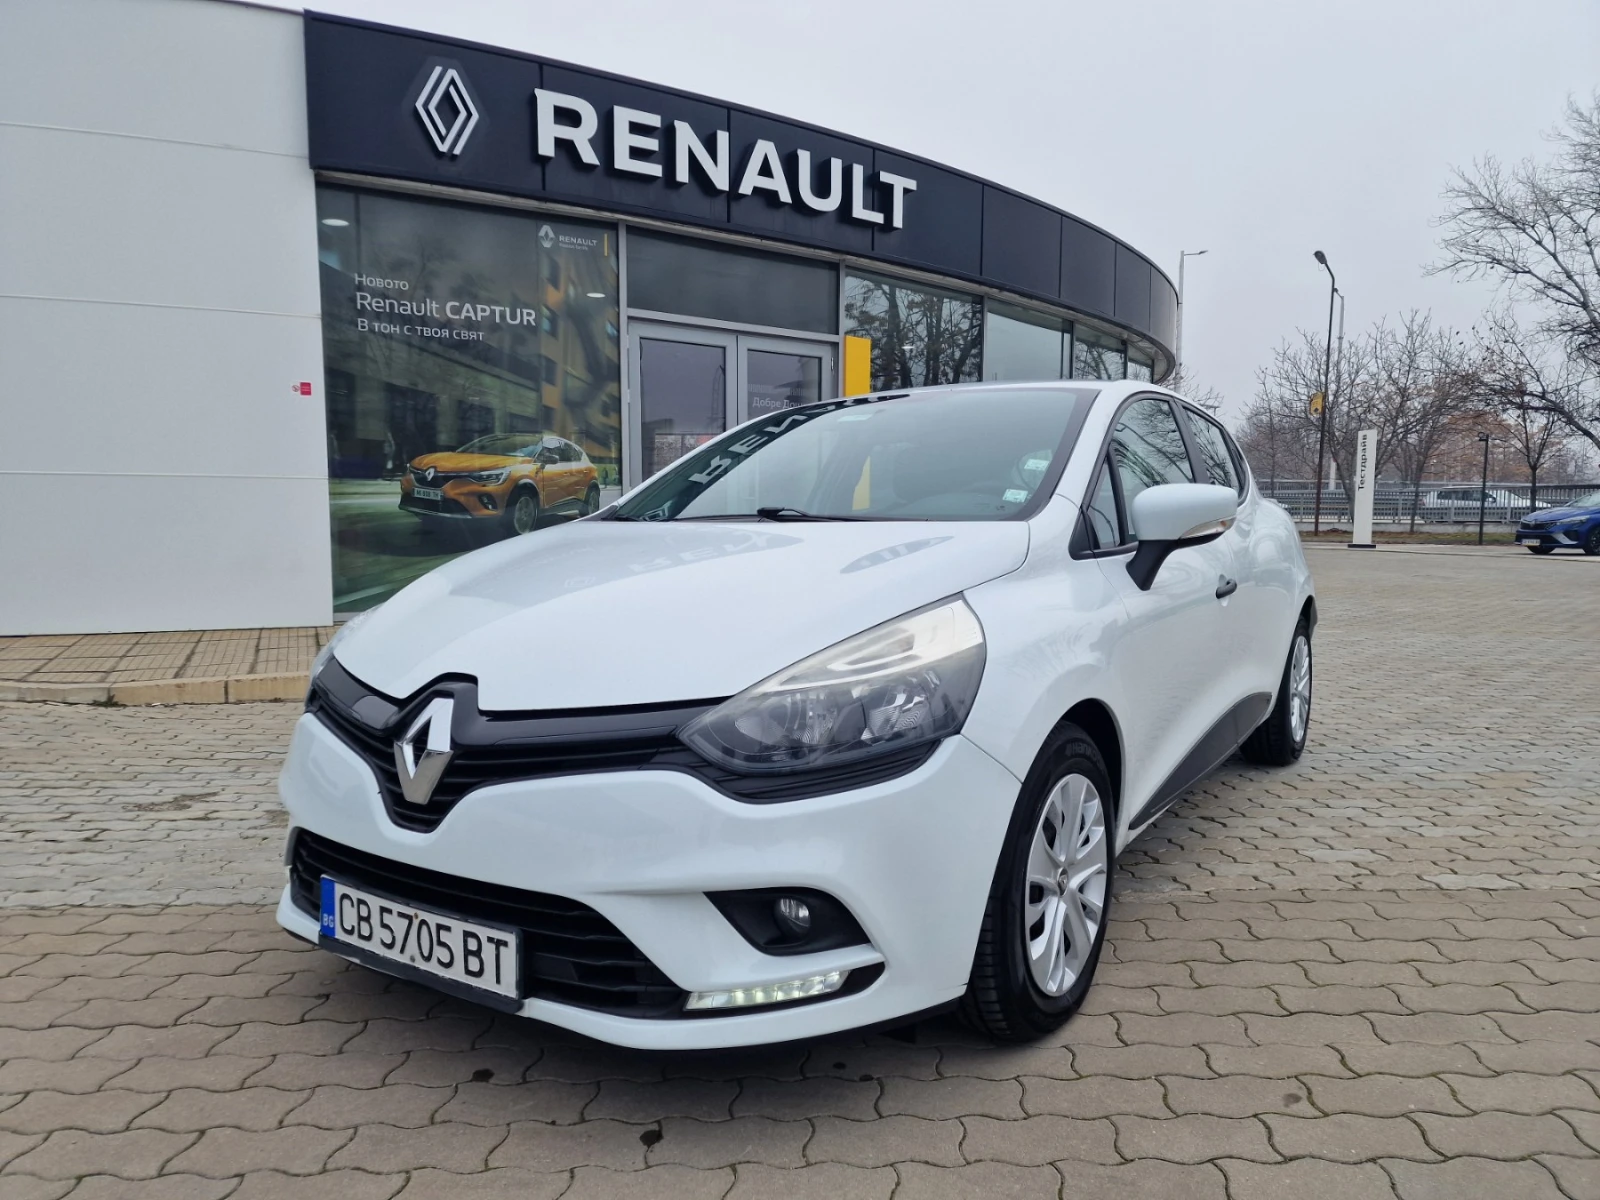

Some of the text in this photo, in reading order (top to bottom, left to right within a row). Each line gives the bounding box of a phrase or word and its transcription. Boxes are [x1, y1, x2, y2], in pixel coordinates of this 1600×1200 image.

[534, 88, 917, 229] RENAULT
[559, 235, 598, 246] RENAULT
[354, 274, 409, 290] Новото
[355, 292, 536, 326] Renault CAPTUR
[357, 319, 485, 341] В тон с твоя свят
[752, 397, 780, 409] Добре
[1358, 434, 1367, 491] Тестдрайв
[322, 916, 334, 927] BG
[379, 905, 455, 969] 5705
[462, 929, 509, 985] BT
